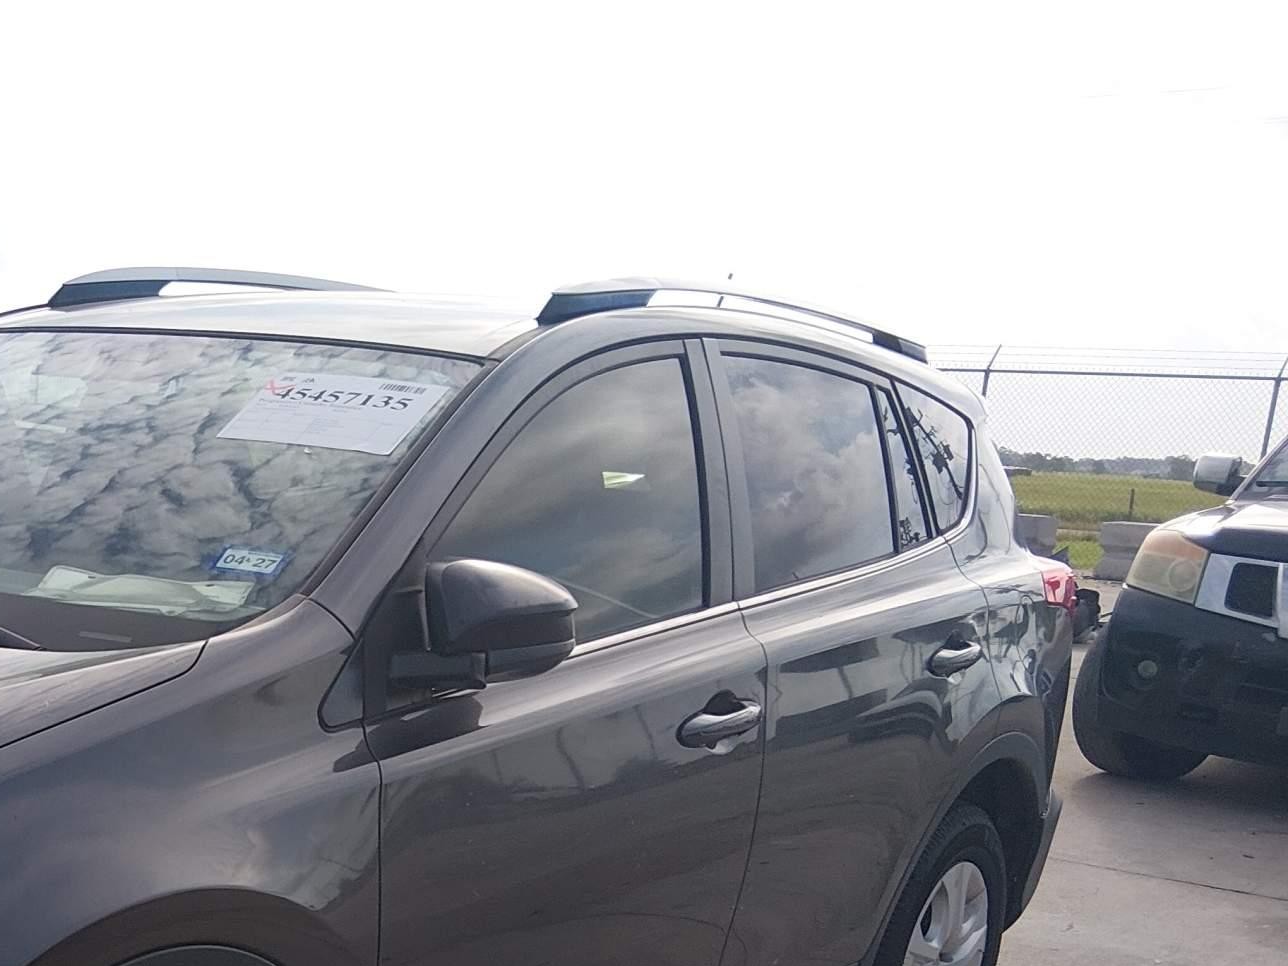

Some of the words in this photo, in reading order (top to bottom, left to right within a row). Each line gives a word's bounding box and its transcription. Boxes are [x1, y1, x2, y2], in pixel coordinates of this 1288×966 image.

[276, 387, 413, 411] 45457135
[223, 553, 246, 565] 04
[252, 557, 278, 569] 27
